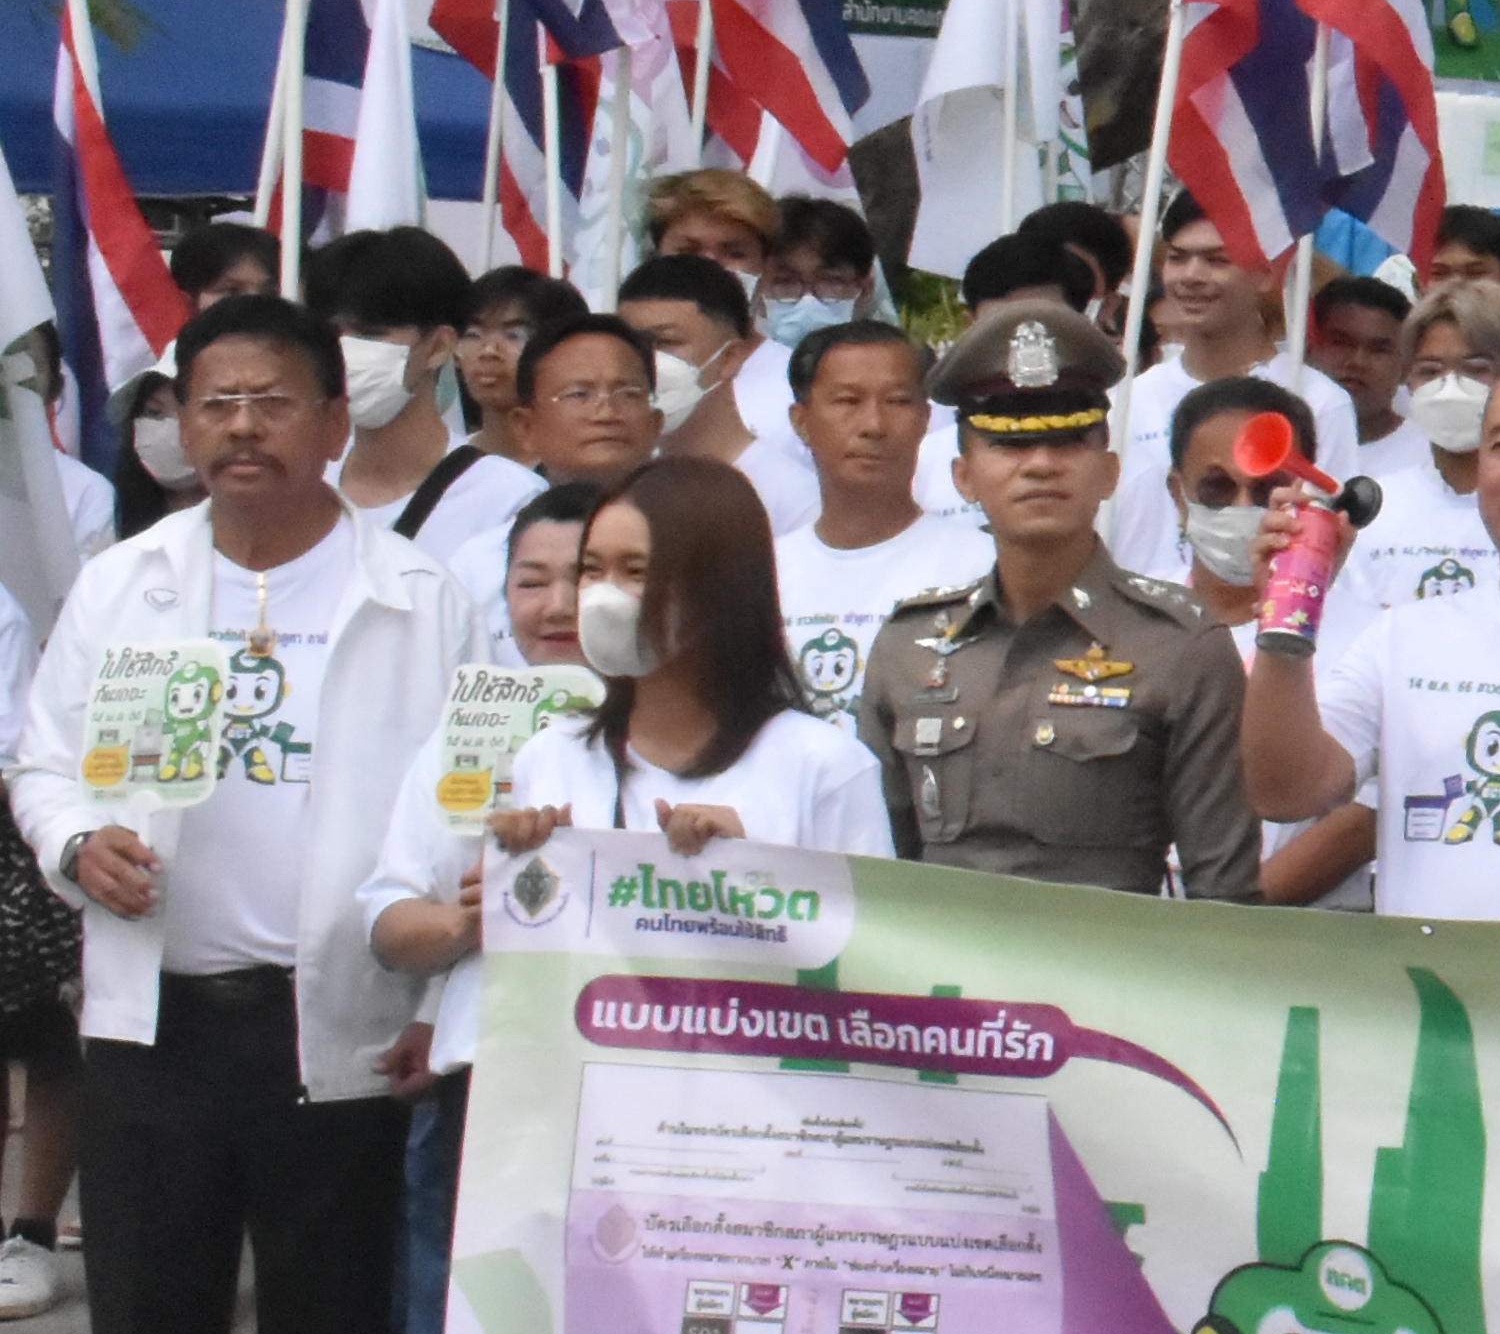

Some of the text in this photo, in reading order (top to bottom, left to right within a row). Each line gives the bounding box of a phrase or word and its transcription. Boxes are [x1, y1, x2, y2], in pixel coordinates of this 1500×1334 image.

[451, 670, 544, 703] ไปใช้สิทธิ
[1408, 677, 1423, 690] 14
[1457, 681, 1474, 693] 66
[607, 864, 821, 924] #ไทยโหวต
[590, 996, 1055, 1062] แบบแบ่งเขต เลือกคนที่รัก
